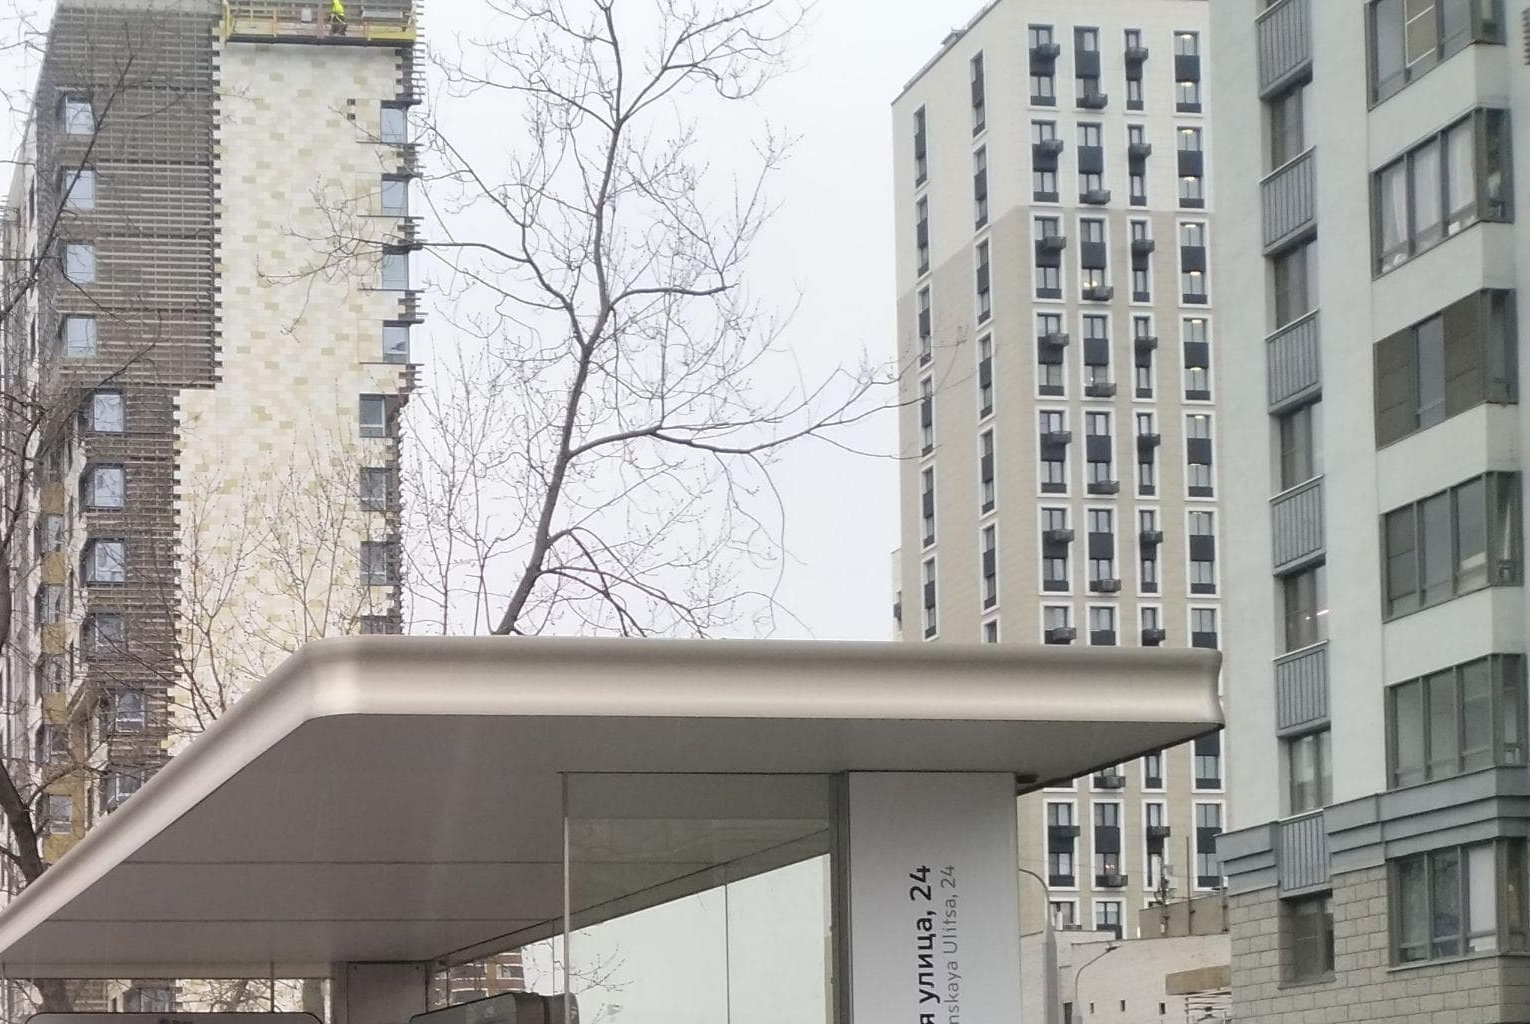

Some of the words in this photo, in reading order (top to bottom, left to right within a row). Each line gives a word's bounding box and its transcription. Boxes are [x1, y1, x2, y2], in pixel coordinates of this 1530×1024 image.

[910, 865, 932, 901] 24
[941, 864, 956, 889] 24
[942, 894, 959, 954] Ulitsa,
[916, 909, 941, 1005] улица,
